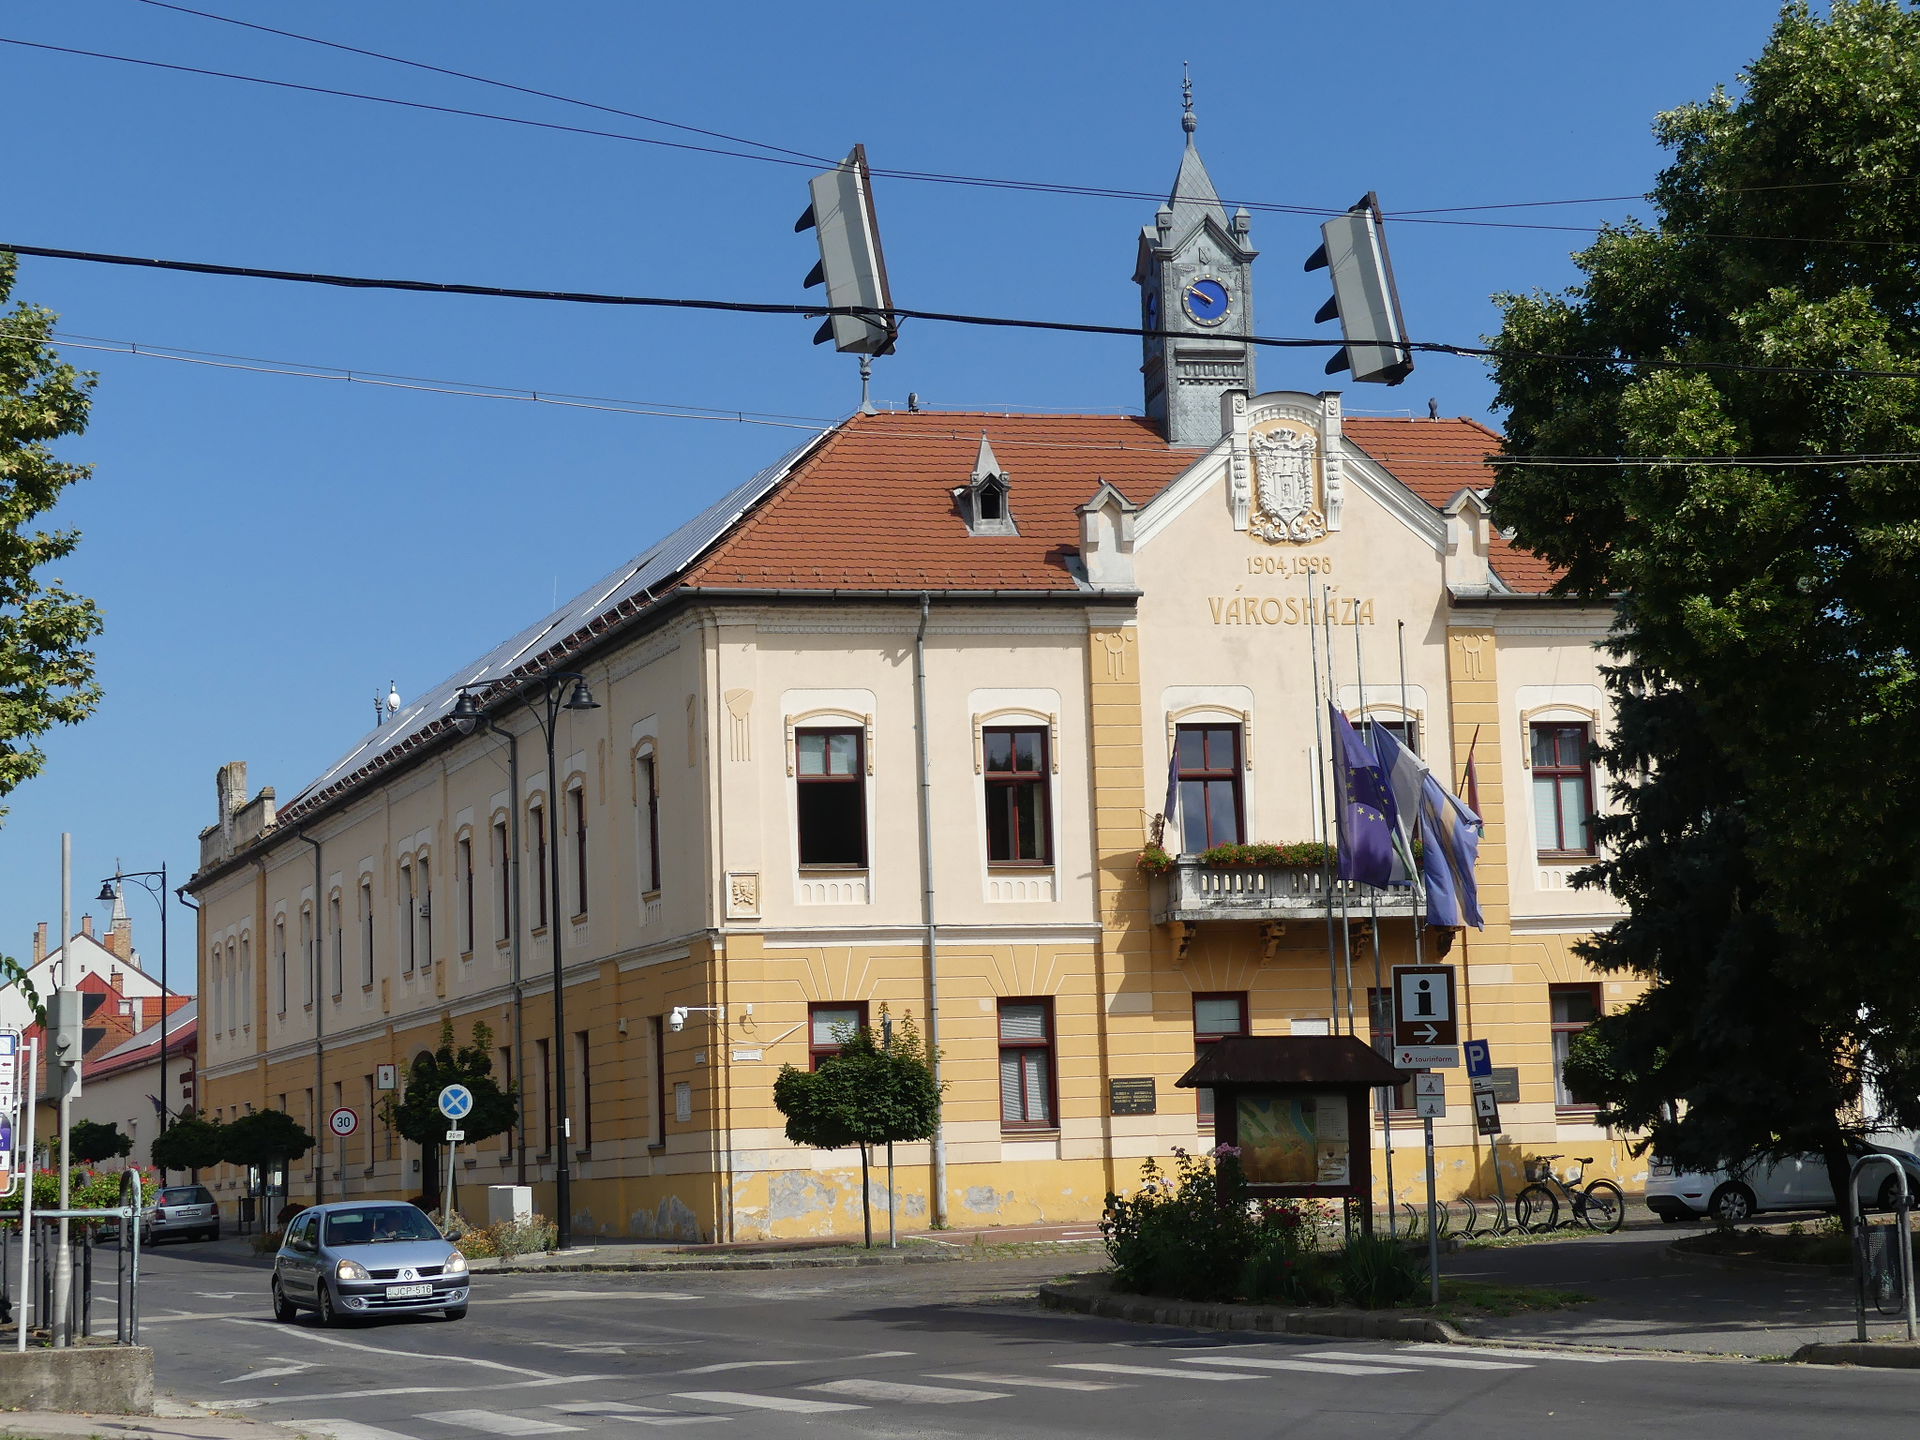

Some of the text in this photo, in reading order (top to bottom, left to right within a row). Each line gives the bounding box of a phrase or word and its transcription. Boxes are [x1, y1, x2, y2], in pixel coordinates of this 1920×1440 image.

[1207, 585, 1376, 625] VÁROSHÁZA
[1415, 1055, 1452, 1063] tourinform
[1468, 1045, 1485, 1072] P
[337, 1117, 350, 1127] 30
[394, 1284, 432, 1296] JCP-516
